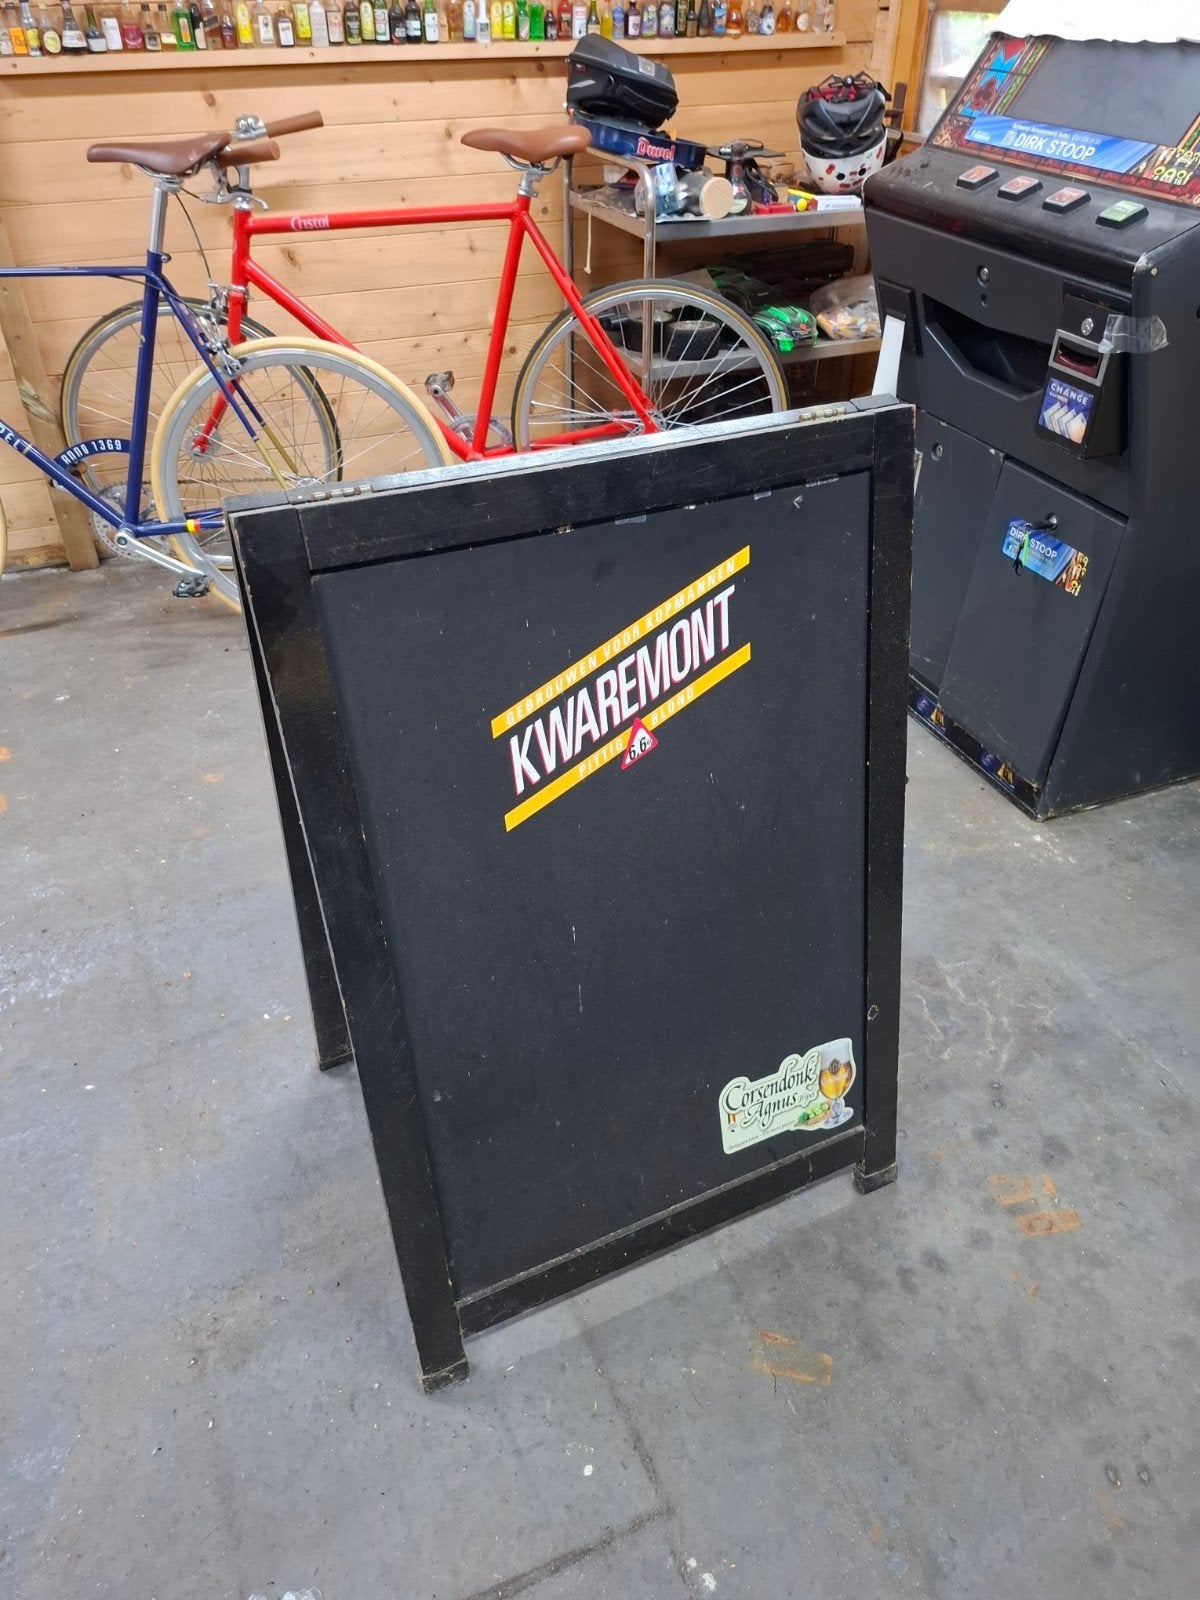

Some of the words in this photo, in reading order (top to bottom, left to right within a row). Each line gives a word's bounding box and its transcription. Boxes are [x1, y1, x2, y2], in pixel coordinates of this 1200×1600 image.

[1013, 133, 1047, 152] DIRK
[1046, 138, 1096, 161] STOOP
[290, 214, 330, 231] Cristal
[1050, 383, 1089, 406] CHANGE
[91, 440, 122, 452] 1369
[1010, 526, 1026, 542] DIR
[1029, 538, 1058, 559] STOOP
[505, 655, 598, 726] GEBROUWEN
[603, 626, 640, 660] VOOR
[645, 557, 736, 629] KOPMANNEN
[509, 584, 736, 797] KWAREMONT
[578, 737, 624, 779] PITTIG
[650, 685, 695, 728] BLOND
[725, 1053, 817, 1111] Corsendonk
[743, 1092, 798, 1128] Agnus
